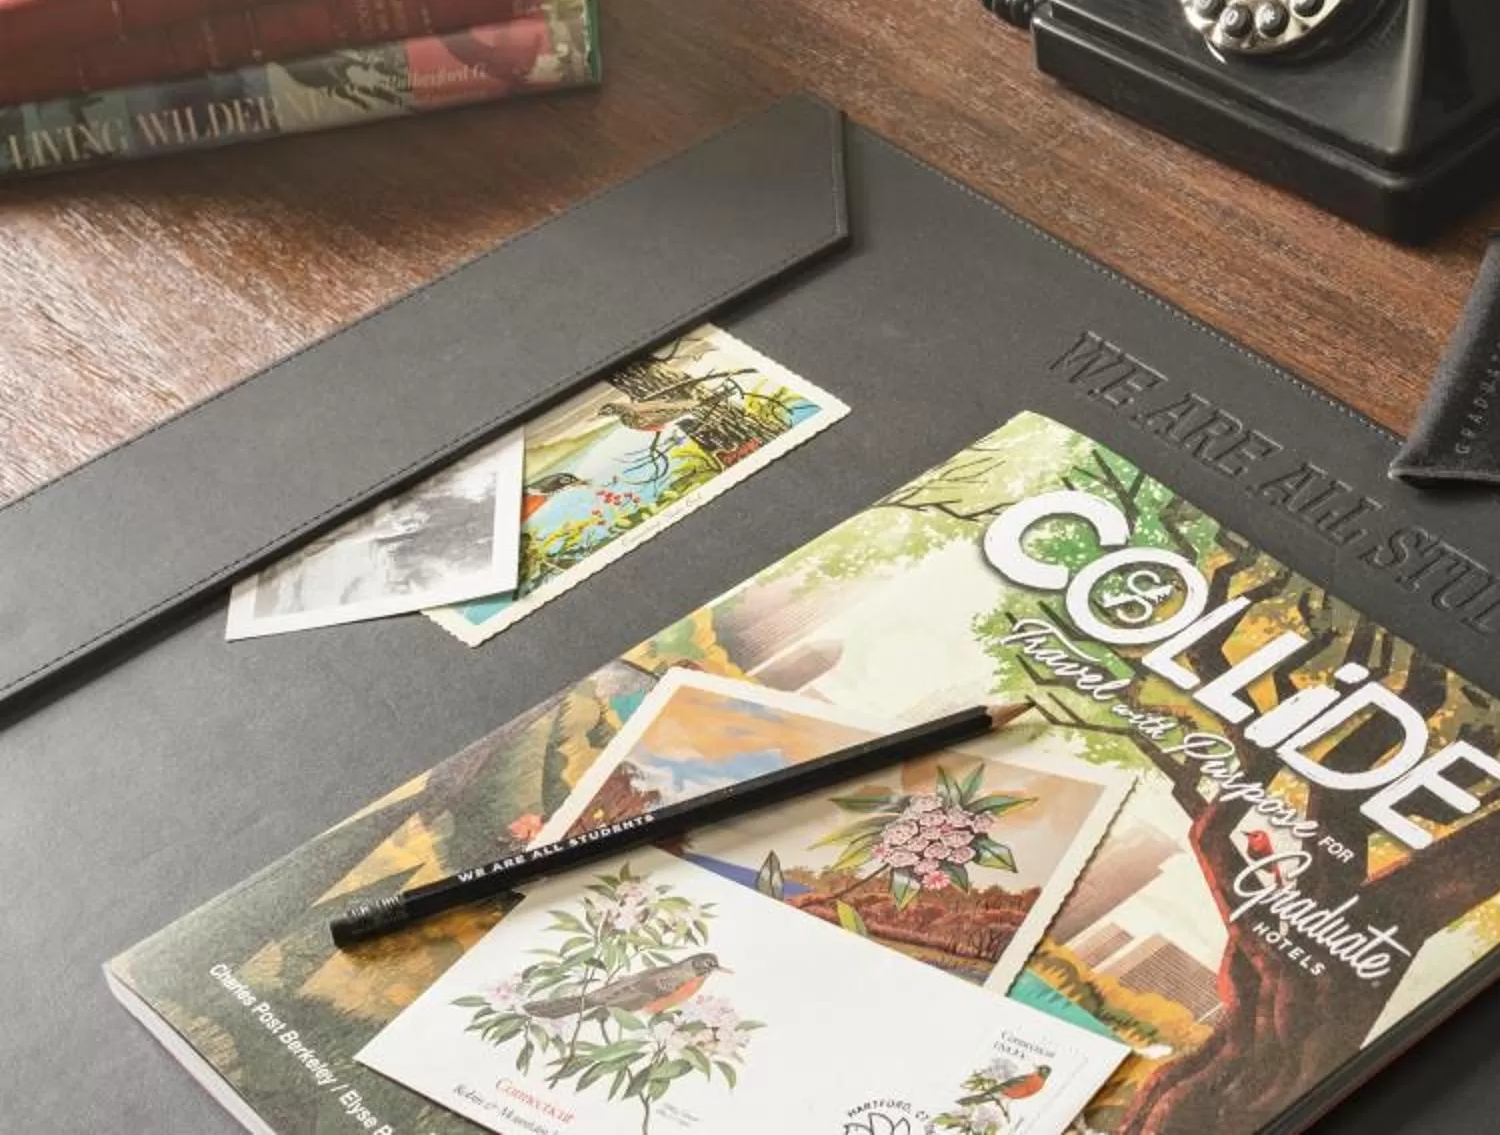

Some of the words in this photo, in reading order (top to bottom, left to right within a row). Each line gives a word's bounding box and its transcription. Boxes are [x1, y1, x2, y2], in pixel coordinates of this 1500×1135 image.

[9, 119, 129, 170] LIVING
[1049, 330, 1170, 410] WE
[1134, 391, 1285, 478] ARE
[1245, 462, 1389, 549] ALL
[998, 618, 1133, 700] Travel
[1112, 703, 1177, 742] with
[1159, 731, 1320, 839] Purpose
[1317, 835, 1355, 864] FOR
[457, 867, 486, 883] WE
[491, 854, 526, 873] ARE
[531, 842, 564, 859] ALL
[569, 814, 655, 848] STUDENTS
[1228, 849, 1412, 979] Graduate
[1252, 921, 1328, 977] HOTELS
[209, 963, 256, 1007] Charles
[252, 1000, 287, 1035] Post
[278, 1029, 338, 1087] Berkeley
[338, 1088, 378, 1129] Elyse
